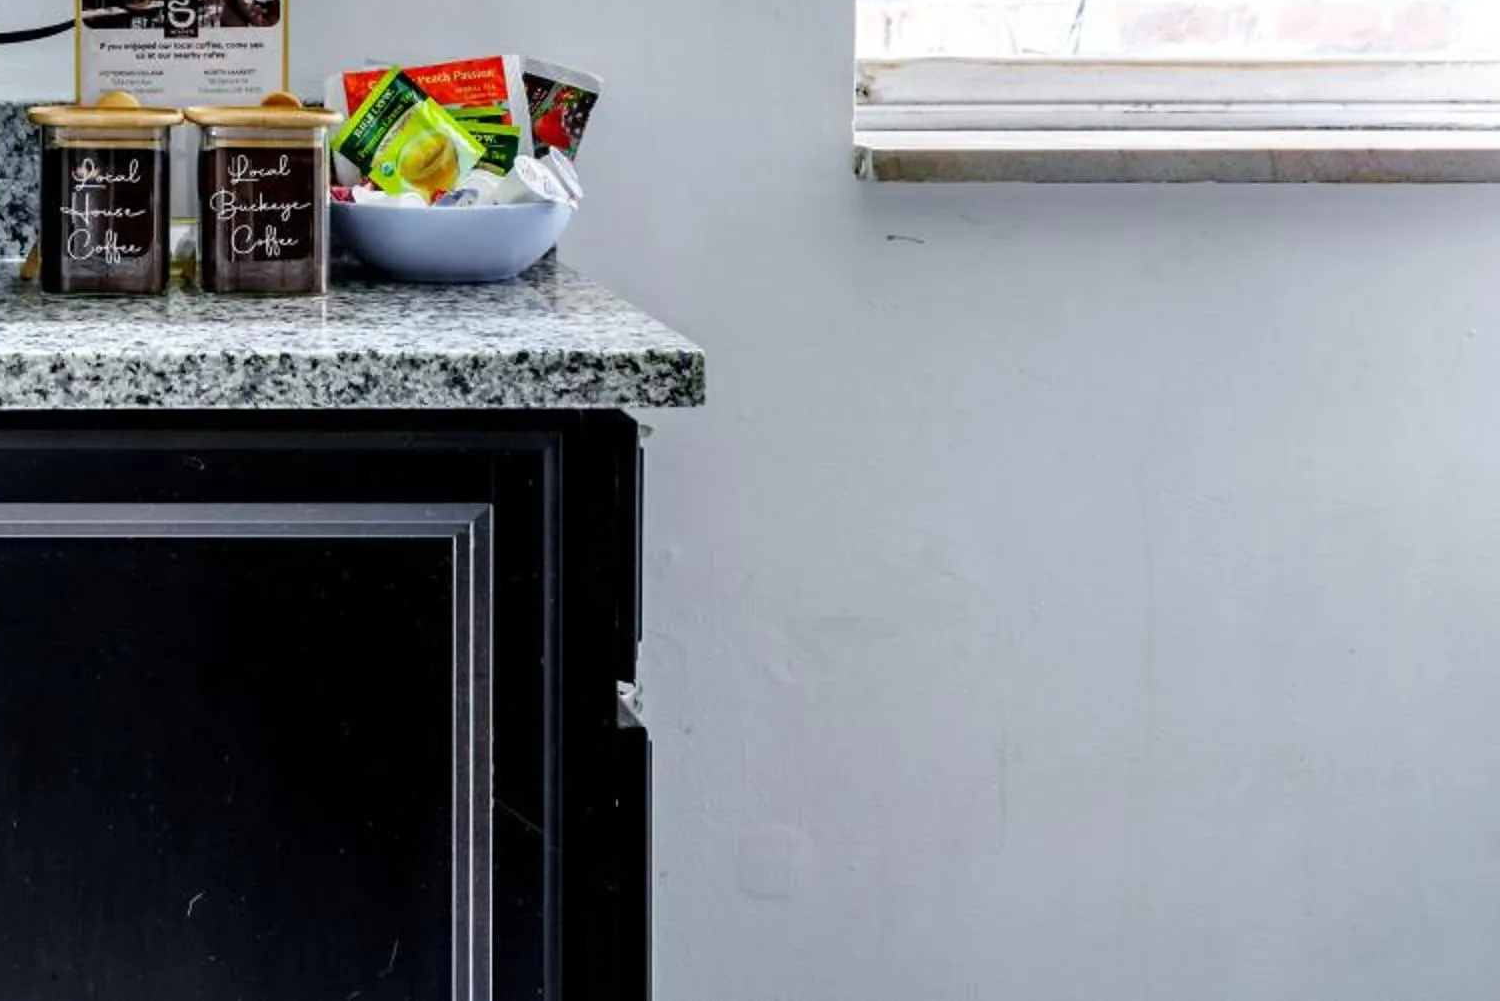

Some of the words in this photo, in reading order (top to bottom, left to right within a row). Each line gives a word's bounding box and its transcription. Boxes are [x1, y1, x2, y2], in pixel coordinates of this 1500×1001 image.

[72, 158, 142, 191] Local
[228, 154, 292, 184] Local
[60, 192, 147, 225] House
[209, 187, 312, 220] Buckeye
[67, 228, 143, 264] Coffee
[231, 225, 299, 258] Coffee
